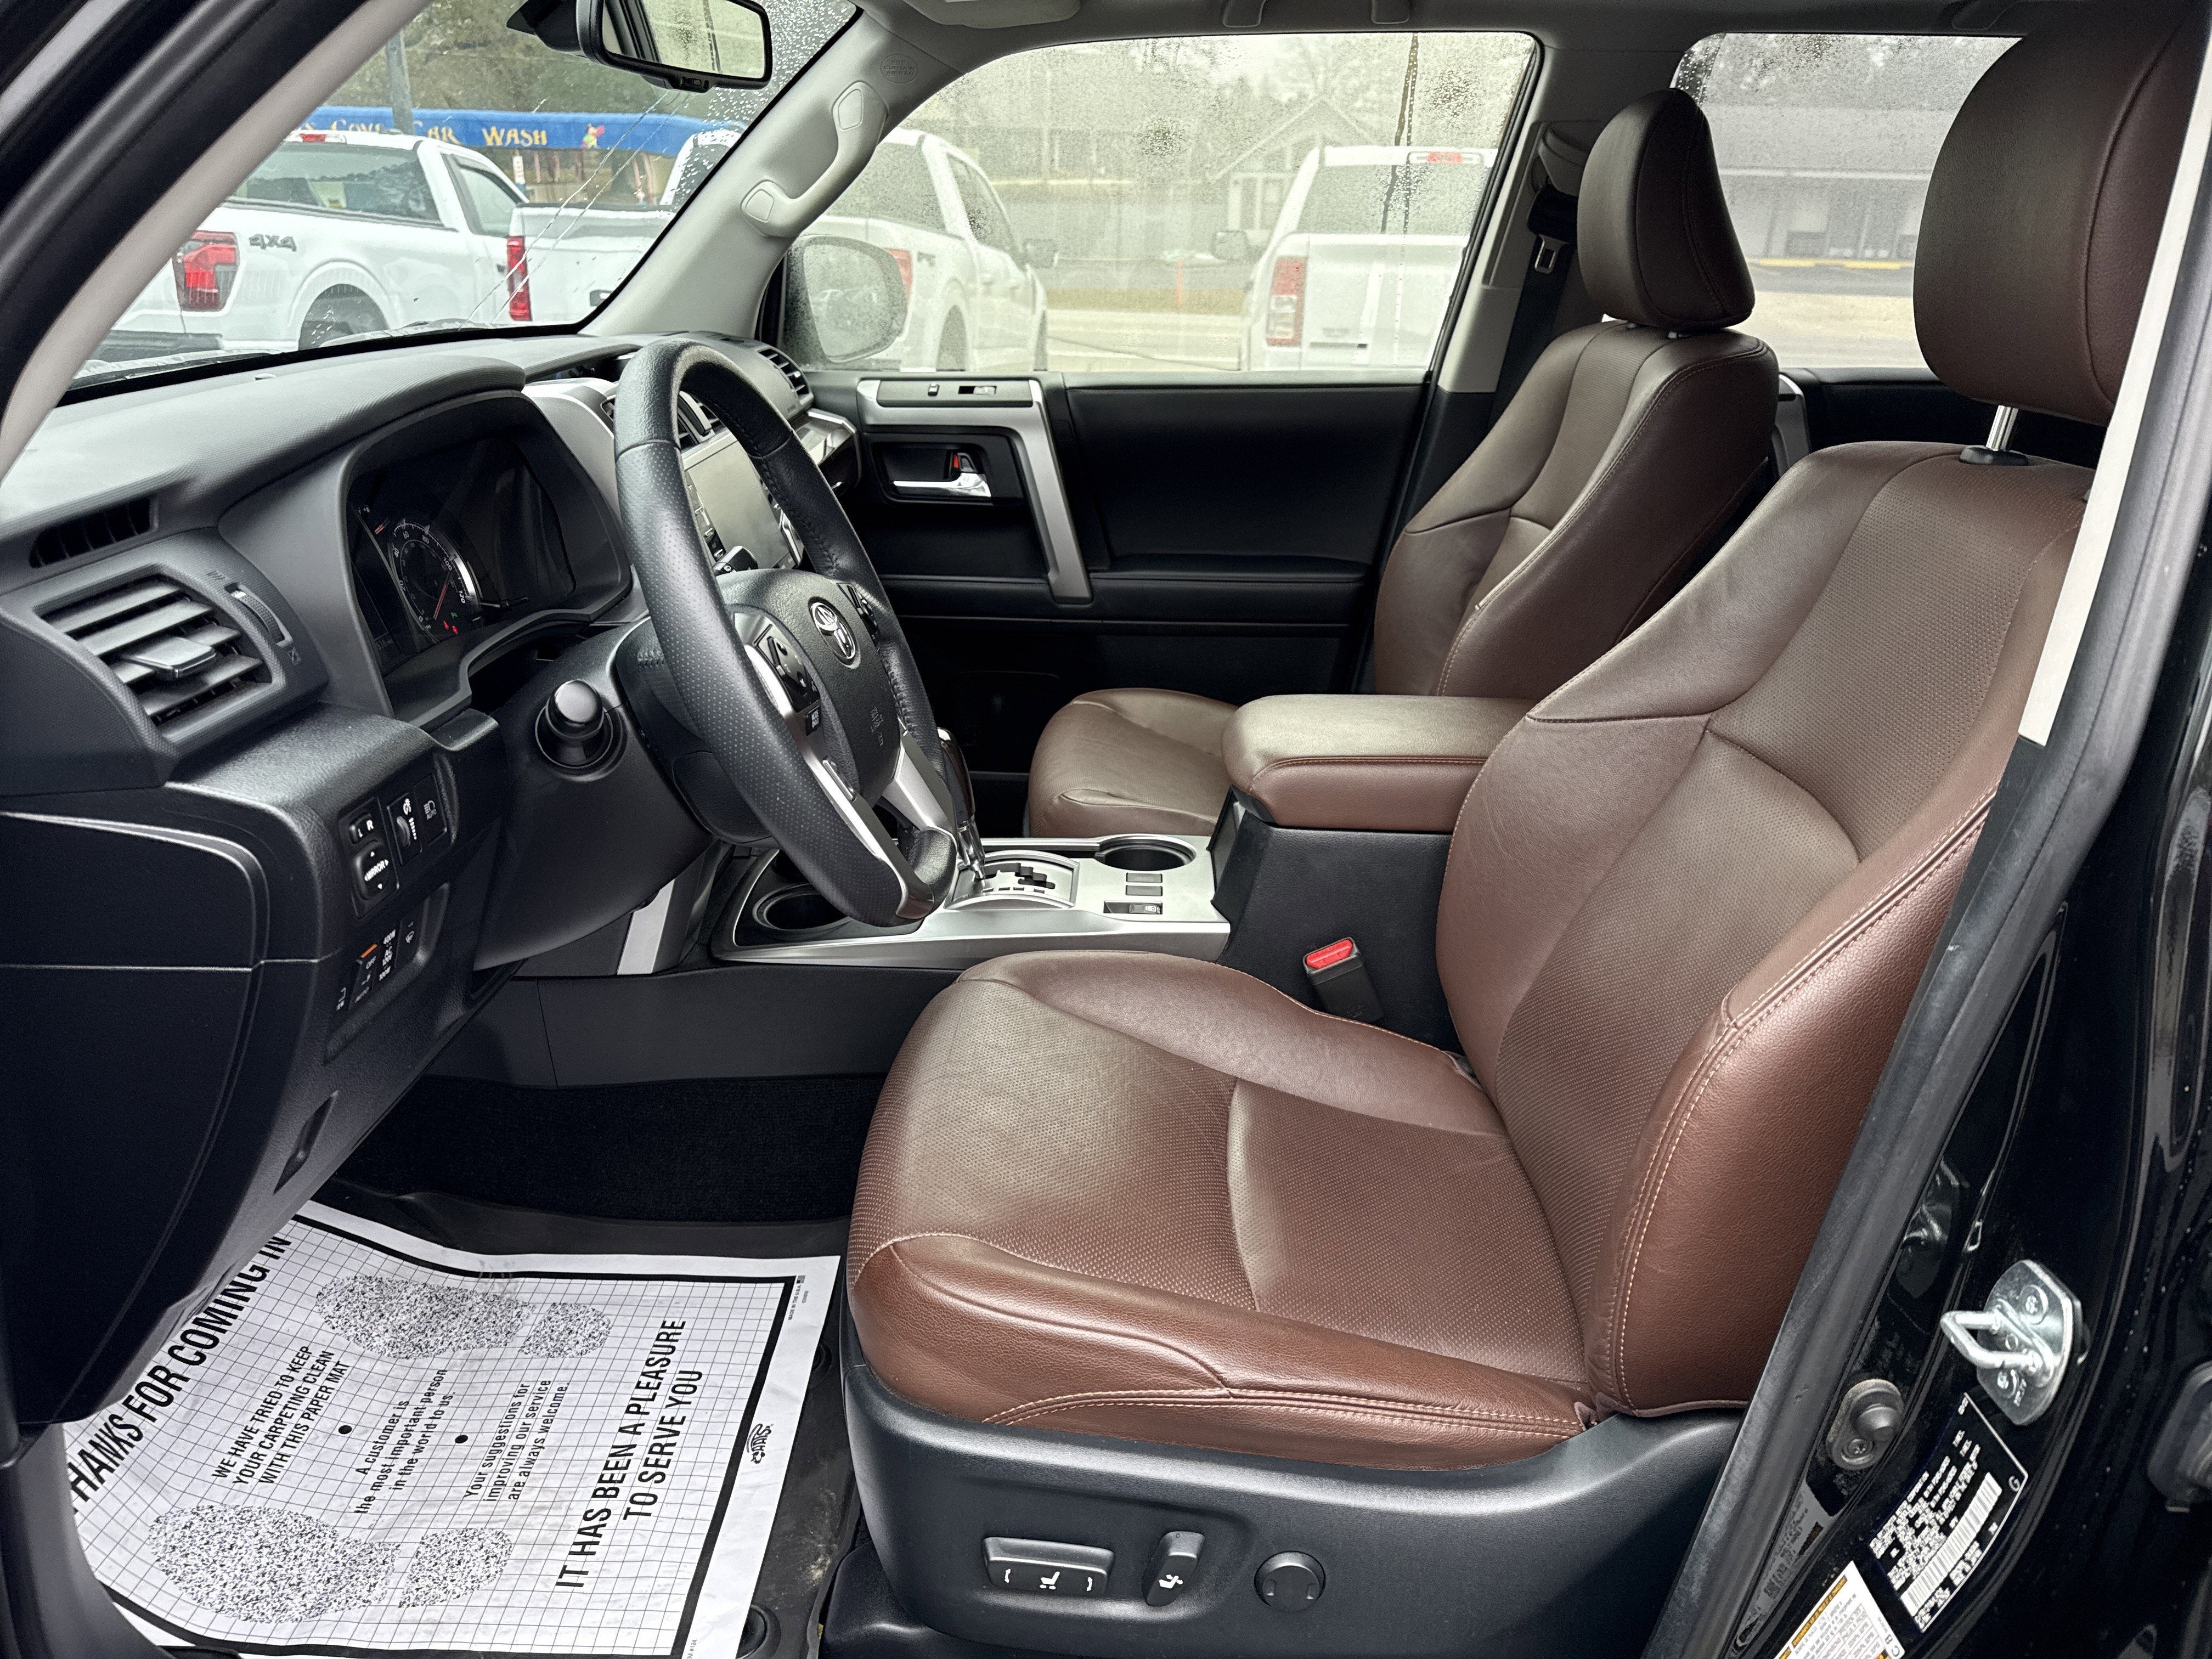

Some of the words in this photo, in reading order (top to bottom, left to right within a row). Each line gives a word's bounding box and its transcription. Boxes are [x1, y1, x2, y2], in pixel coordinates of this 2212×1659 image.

[481, 126, 548, 147] WASH
[443, 556, 453, 571] 100
[358, 828, 363, 838] L
[366, 820, 374, 831] R
[365, 859, 386, 882] MIRROR
[68, 1414, 143, 1514] HANKS
[122, 1364, 191, 1423] FOR
[167, 1264, 270, 1366] COMING
[258, 1236, 292, 1260] IN
[624, 1320, 686, 1415] PLEASURE
[438, 1392, 456, 1407] us.
[665, 1370, 703, 1410] YOU
[211, 1458, 238, 1478] WE
[227, 1425, 259, 1457] HAVE
[250, 1391, 283, 1423] TRIED
[274, 1374, 295, 1387] TO
[286, 1346, 313, 1373] KEEP
[232, 1451, 267, 1484] YOUR
[258, 1385, 311, 1450] CARPETING
[302, 1350, 335, 1384] CLEAN
[258, 1452, 291, 1484] WITH
[281, 1423, 310, 1449] THIS
[301, 1385, 335, 1421] PAPER
[325, 1361, 350, 1384] MAT
[428, 1409, 445, 1419] to
[618, 1422, 646, 1436] A
[353, 1495, 376, 1514] the
[369, 1463, 396, 1492] most
[385, 1406, 427, 1460] important
[420, 1369, 448, 1403] person
[355, 1467, 371, 1475] A
[364, 1413, 403, 1464] customer
[392, 1400, 410, 1410] is
[412, 1423, 438, 1455] world
[463, 1471, 488, 1498] Your
[481, 1401, 522, 1468] suggestions
[513, 1383, 531, 1398] for
[482, 1444, 525, 1502] improving
[515, 1421, 532, 1440] our
[525, 1380, 551, 1418] service
[508, 1480, 526, 1500] are
[518, 1437, 545, 1477] always
[538, 1381, 570, 1435] welcome.
[637, 1415, 687, 1484] SERVE
[388, 1480, 408, 1490] in
[397, 1458, 419, 1476] the
[591, 1443, 638, 1500] BEEN
[2008, 1476, 2020, 1492] G
[623, 1492, 659, 1521] TO
[568, 1508, 612, 1556] HAS
[555, 1564, 590, 1588] IT
